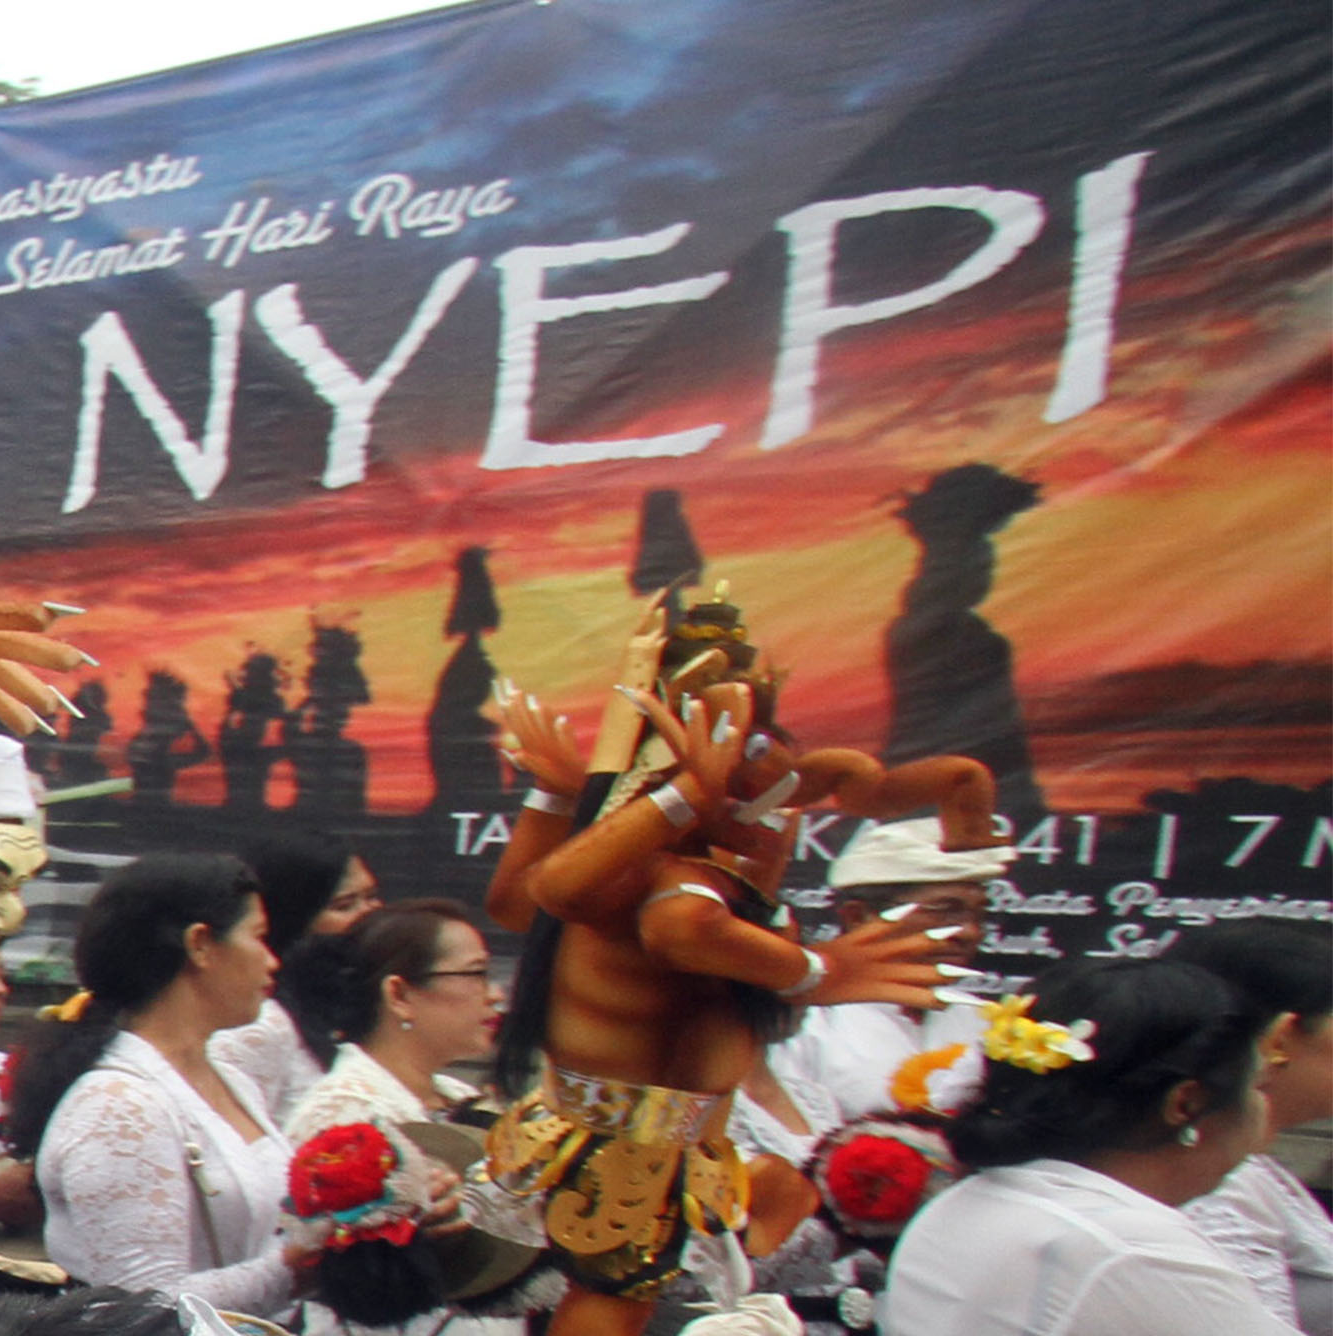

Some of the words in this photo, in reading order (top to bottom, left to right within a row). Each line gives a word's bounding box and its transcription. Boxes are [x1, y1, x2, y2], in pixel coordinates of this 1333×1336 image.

[62, 150, 1155, 514] NYEPI
[200, 197, 335, 268] Hari
[347, 172, 517, 240] Raya
